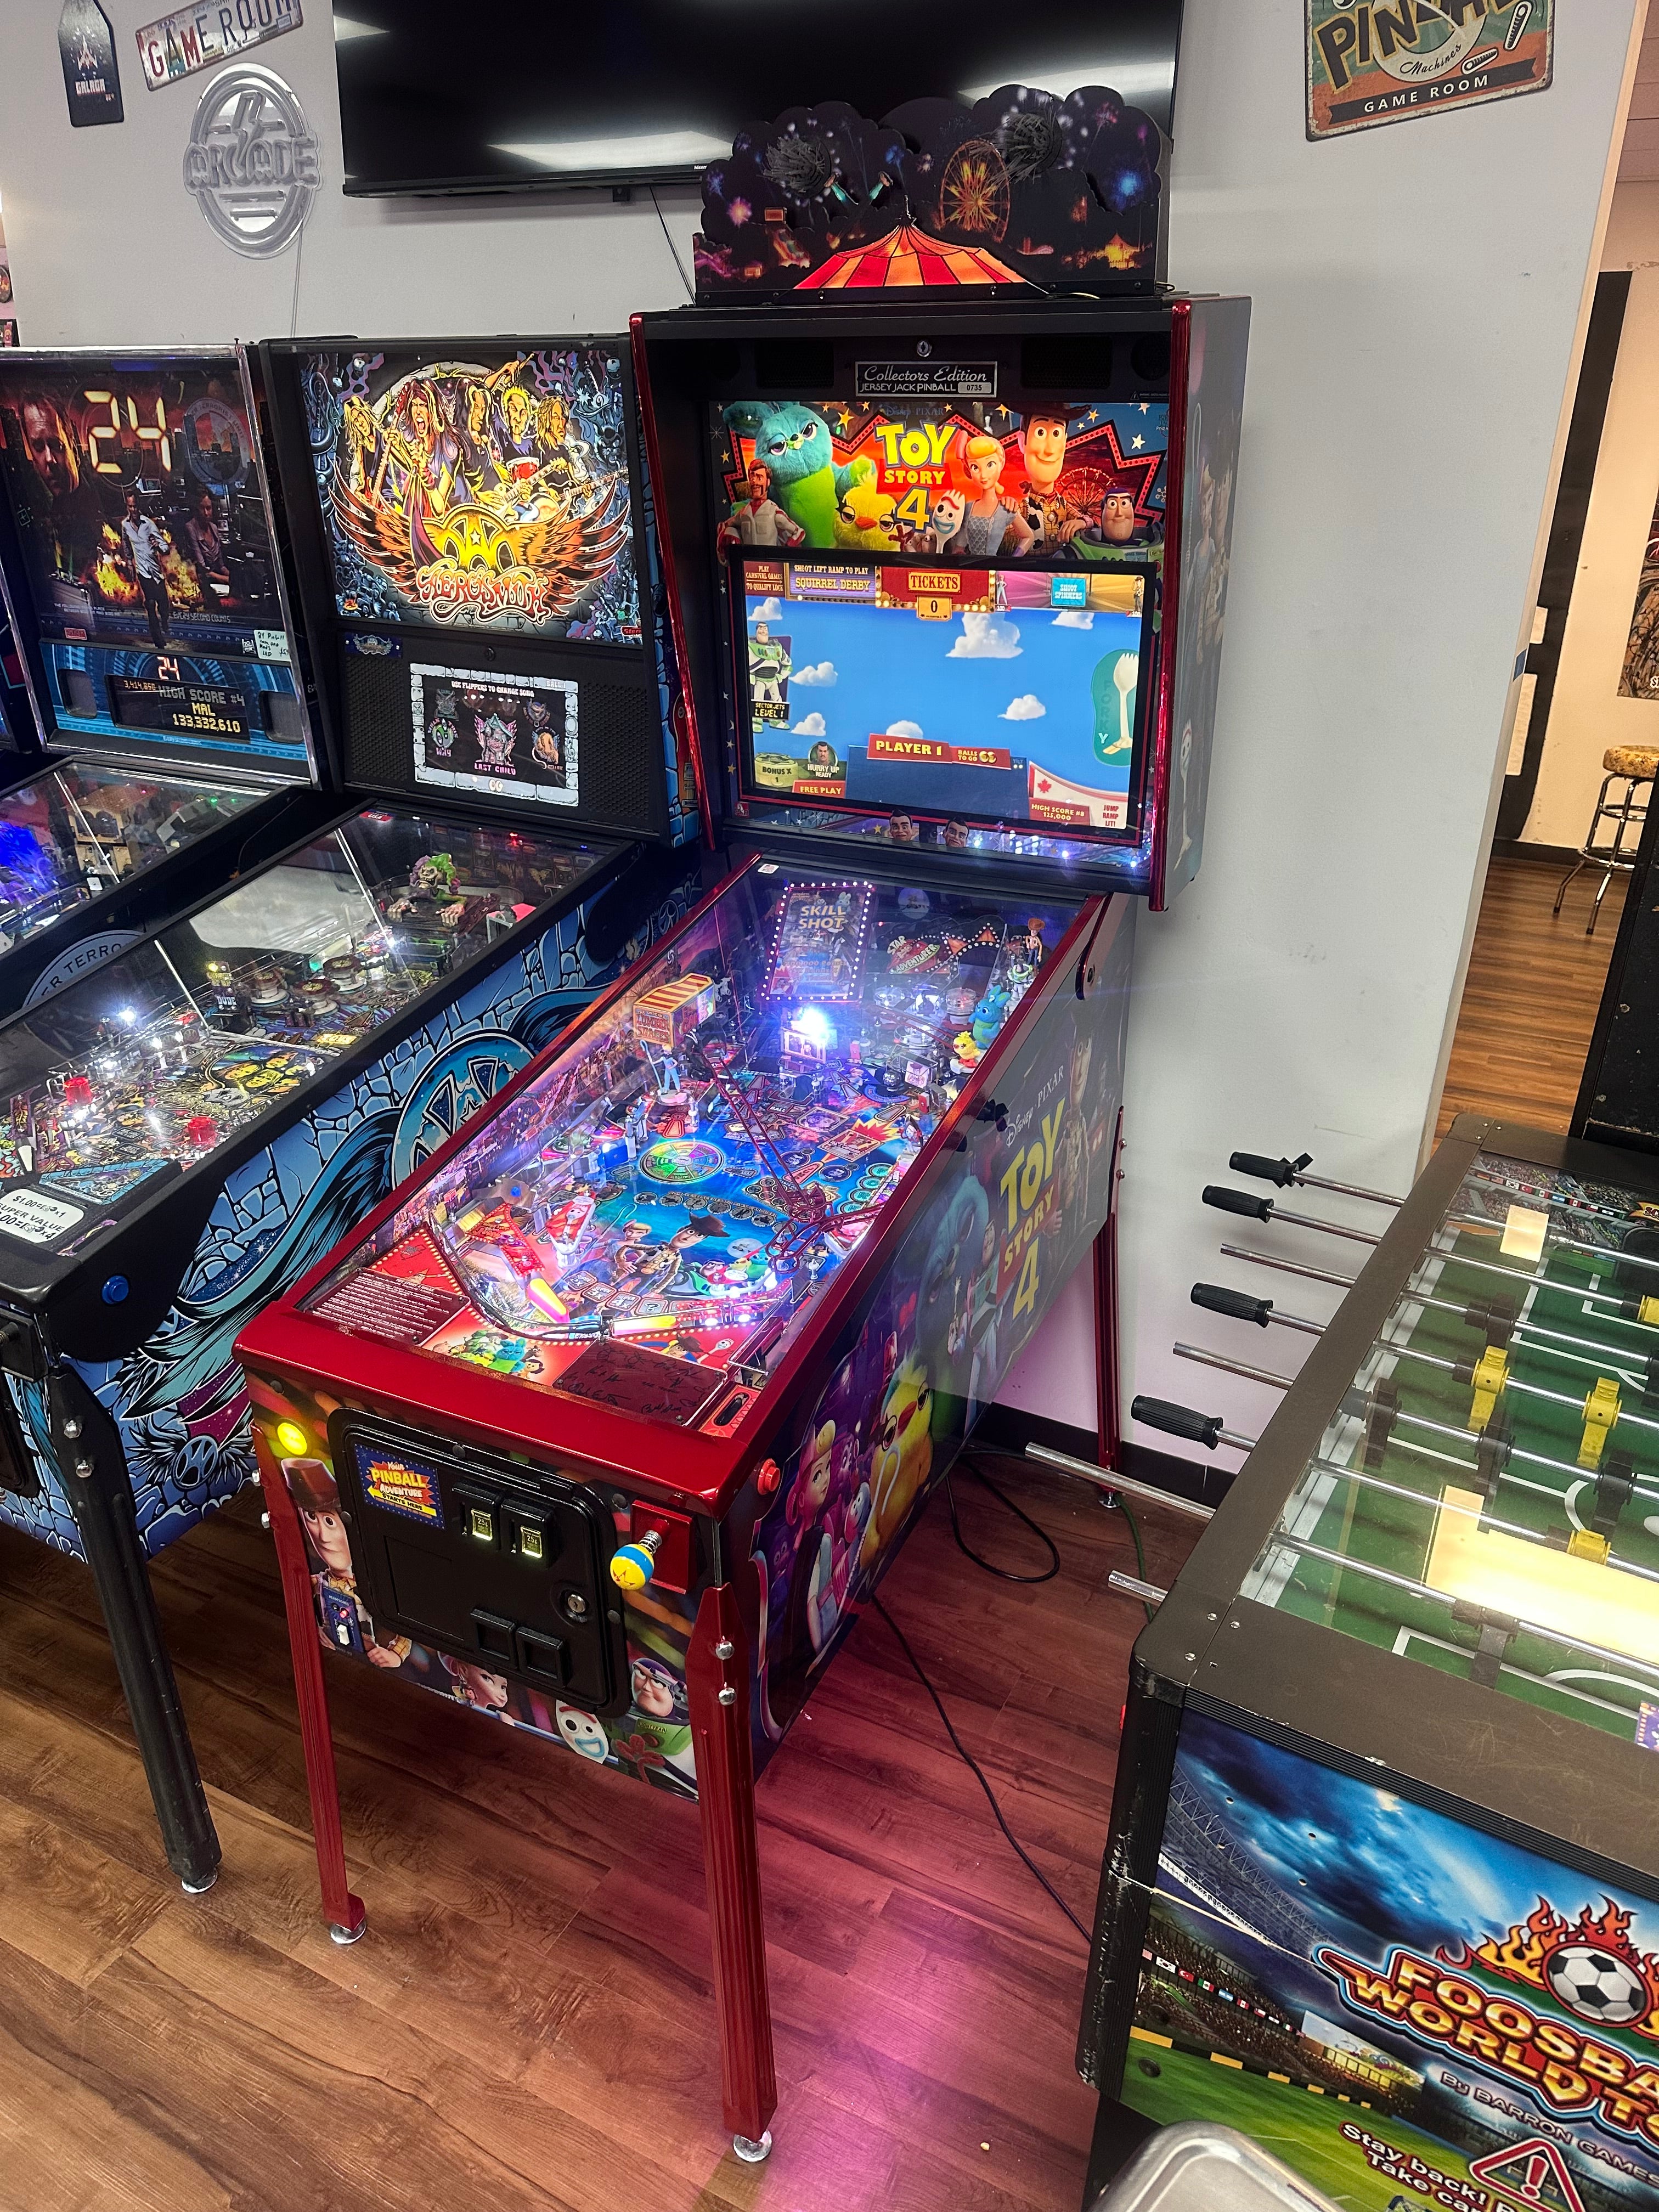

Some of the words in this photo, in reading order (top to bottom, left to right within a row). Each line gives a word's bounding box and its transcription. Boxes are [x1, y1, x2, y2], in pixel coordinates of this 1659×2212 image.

[148, 14, 214, 77] GAME
[1400, 43, 1462, 75] Machines
[75, 78, 106, 96] GALAGA
[1364, 91, 1418, 113] GAME
[1430, 75, 1488, 98] ROOM
[183, 138, 317, 188] ARCADE
[864, 365, 929, 381] Collectors
[934, 365, 987, 381] Edition
[860, 383, 892, 392] JERSEY
[892, 383, 916, 392] JACK
[917, 383, 956, 392] PINBALL
[916, 407, 944, 416] PIXAR
[83, 390, 172, 473] 24
[875, 421, 958, 468] TOY
[884, 470, 946, 484] STORY
[896, 487, 931, 532] 4
[753, 583, 772, 591] QUALIFY
[795, 577, 838, 592] SQUIRREL
[840, 579, 871, 591] DERBY
[911, 575, 958, 590] TICKETS
[1060, 584, 1077, 592] SHOOT
[416, 560, 552, 625] AEROSMITH
[930, 600, 938, 613] 0
[157, 656, 180, 681] 24
[159, 686, 186, 700] HIGH
[190, 689, 227, 705] SCORE
[230, 693, 245, 707] #4
[462, 682, 487, 692] FLIPPERS
[496, 686, 518, 696] CHANGE
[519, 690, 535, 698] SONG
[191, 702, 216, 716] MAL
[755, 708, 778, 718] LEVEL
[172, 713, 241, 733] 133,332,610
[876, 740, 932, 755] PLAYER
[936, 746, 942, 756] 1
[474, 762, 492, 772] LAST
[762, 766, 785, 775] BONUS
[808, 764, 829, 772] HURRY
[1031, 804, 1050, 812] HIGH
[1052, 806, 1074, 816] SCORE
[1043, 811, 1071, 821] 125,000
[800, 906, 847, 916] SKILL
[798, 918, 845, 929] SHOT
[887, 935, 907, 955] STAR
[896, 944, 938, 973] ADVENTURER
[217, 996, 237, 1006] DUDE
[1037, 1065, 1064, 1109] PIXAR
[1000, 1097, 1065, 1233] TOY
[30, 1215, 65, 1232] VALUE
[1004, 1184, 1054, 1273] STORY
[1013, 1238, 1040, 1319] 4
[595, 1285, 611, 1294] SUPER
[370, 1468, 427, 1488] PINBALL
[380, 1483, 423, 1498] ADVENTURE
[382, 1493, 406, 1505] STARTS
[407, 1501, 423, 1510] HERE
[1339, 1967, 1591, 2102] WORLD
[1442, 2071, 1470, 2096] By
[1474, 2089, 1573, 2144] BARRON
[1342, 2123, 1405, 2162] Stay
[1410, 2157, 1487, 2205] back!
[1367, 2150, 1429, 2193] Take
